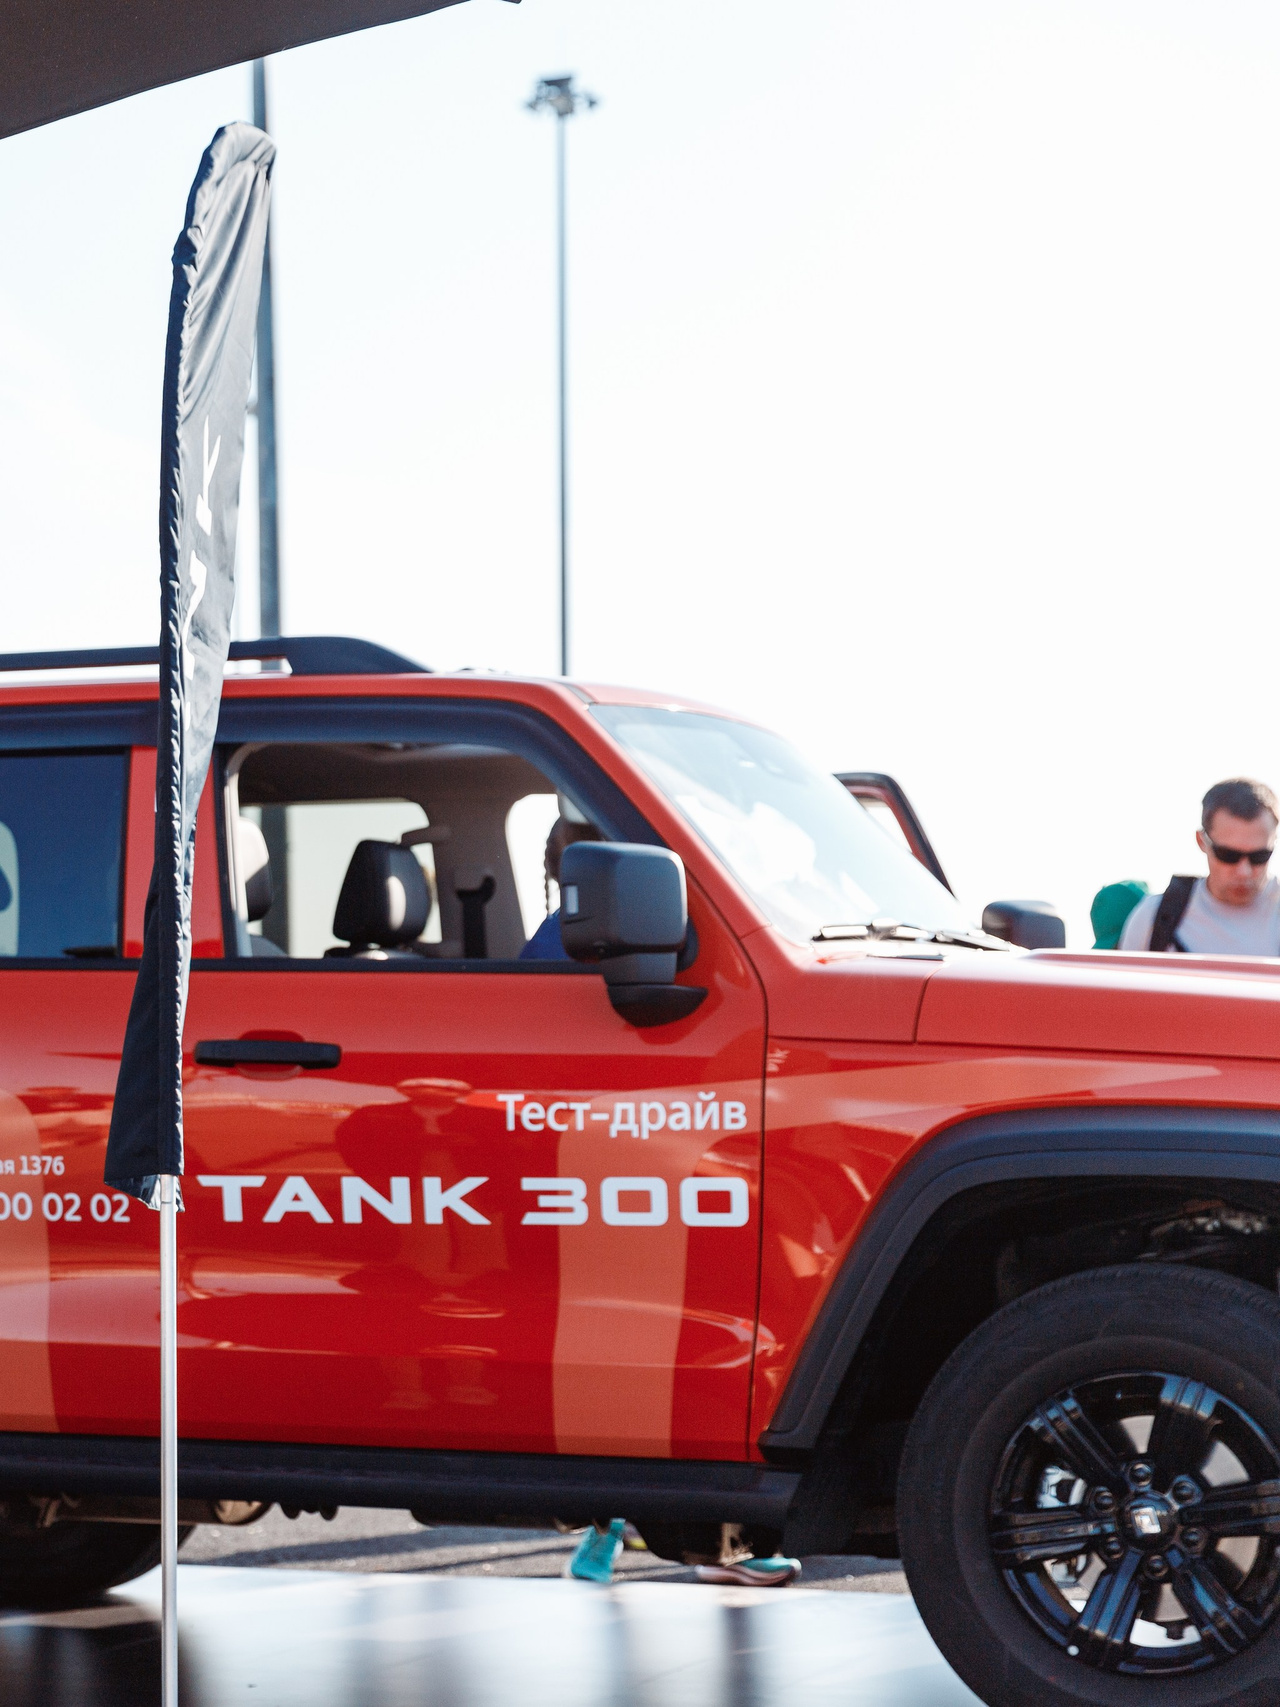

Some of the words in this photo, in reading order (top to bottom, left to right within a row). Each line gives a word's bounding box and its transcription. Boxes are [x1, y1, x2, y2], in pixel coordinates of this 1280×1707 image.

[496, 1091, 747, 1140] Тест-драйв
[19, 1154, 66, 1176] 1376
[41, 1192, 82, 1222] 02
[90, 1192, 131, 1223] 02
[195, 1174, 493, 1226] TANK
[519, 1176, 751, 1228] 300
